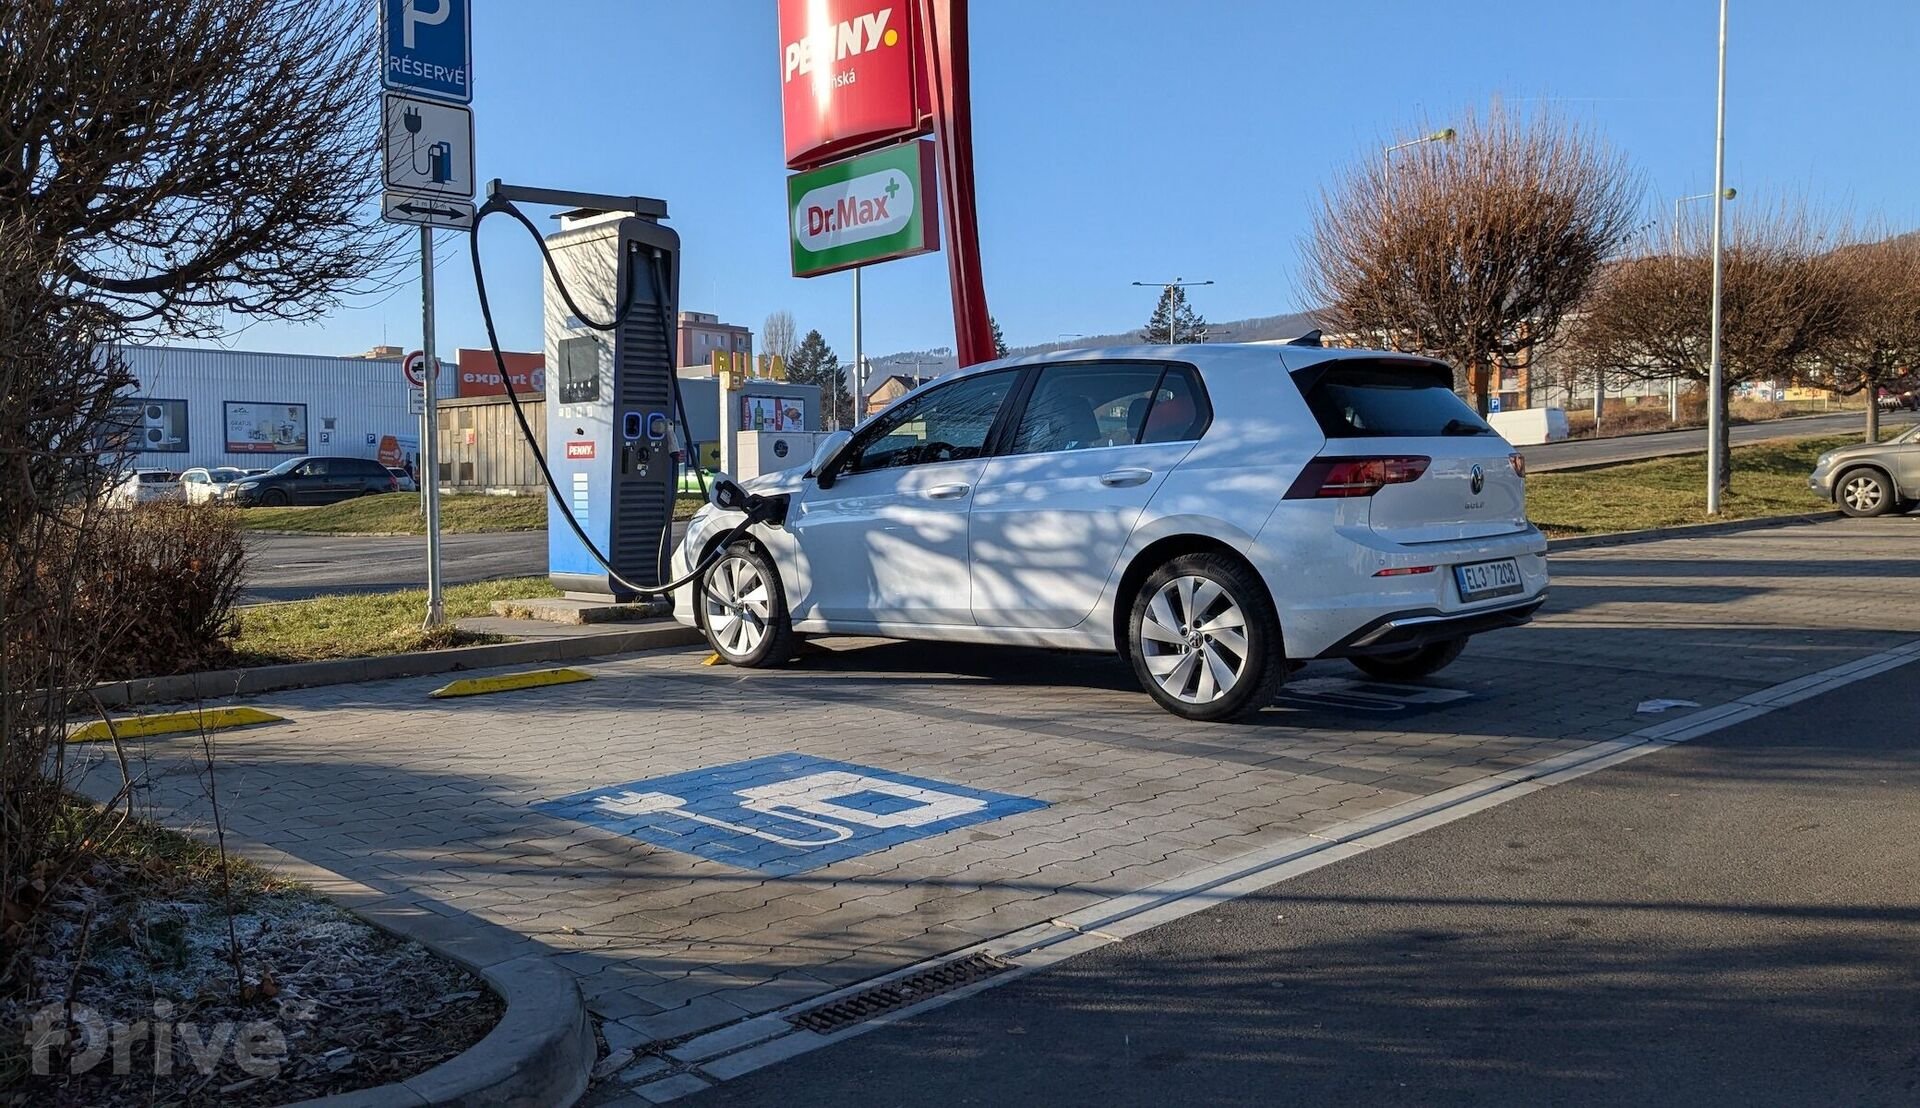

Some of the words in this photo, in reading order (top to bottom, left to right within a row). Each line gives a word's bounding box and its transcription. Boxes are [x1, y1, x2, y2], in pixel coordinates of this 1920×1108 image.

[402, 0, 450, 50] P
[389, 54, 465, 86] RÉSERVÉ
[808, 194, 890, 237] Dr.Max
[1491, 399, 1499, 409] P
[322, 433, 328, 441] P
[368, 434, 374, 442] P
[1464, 566, 1488, 590] EL3
